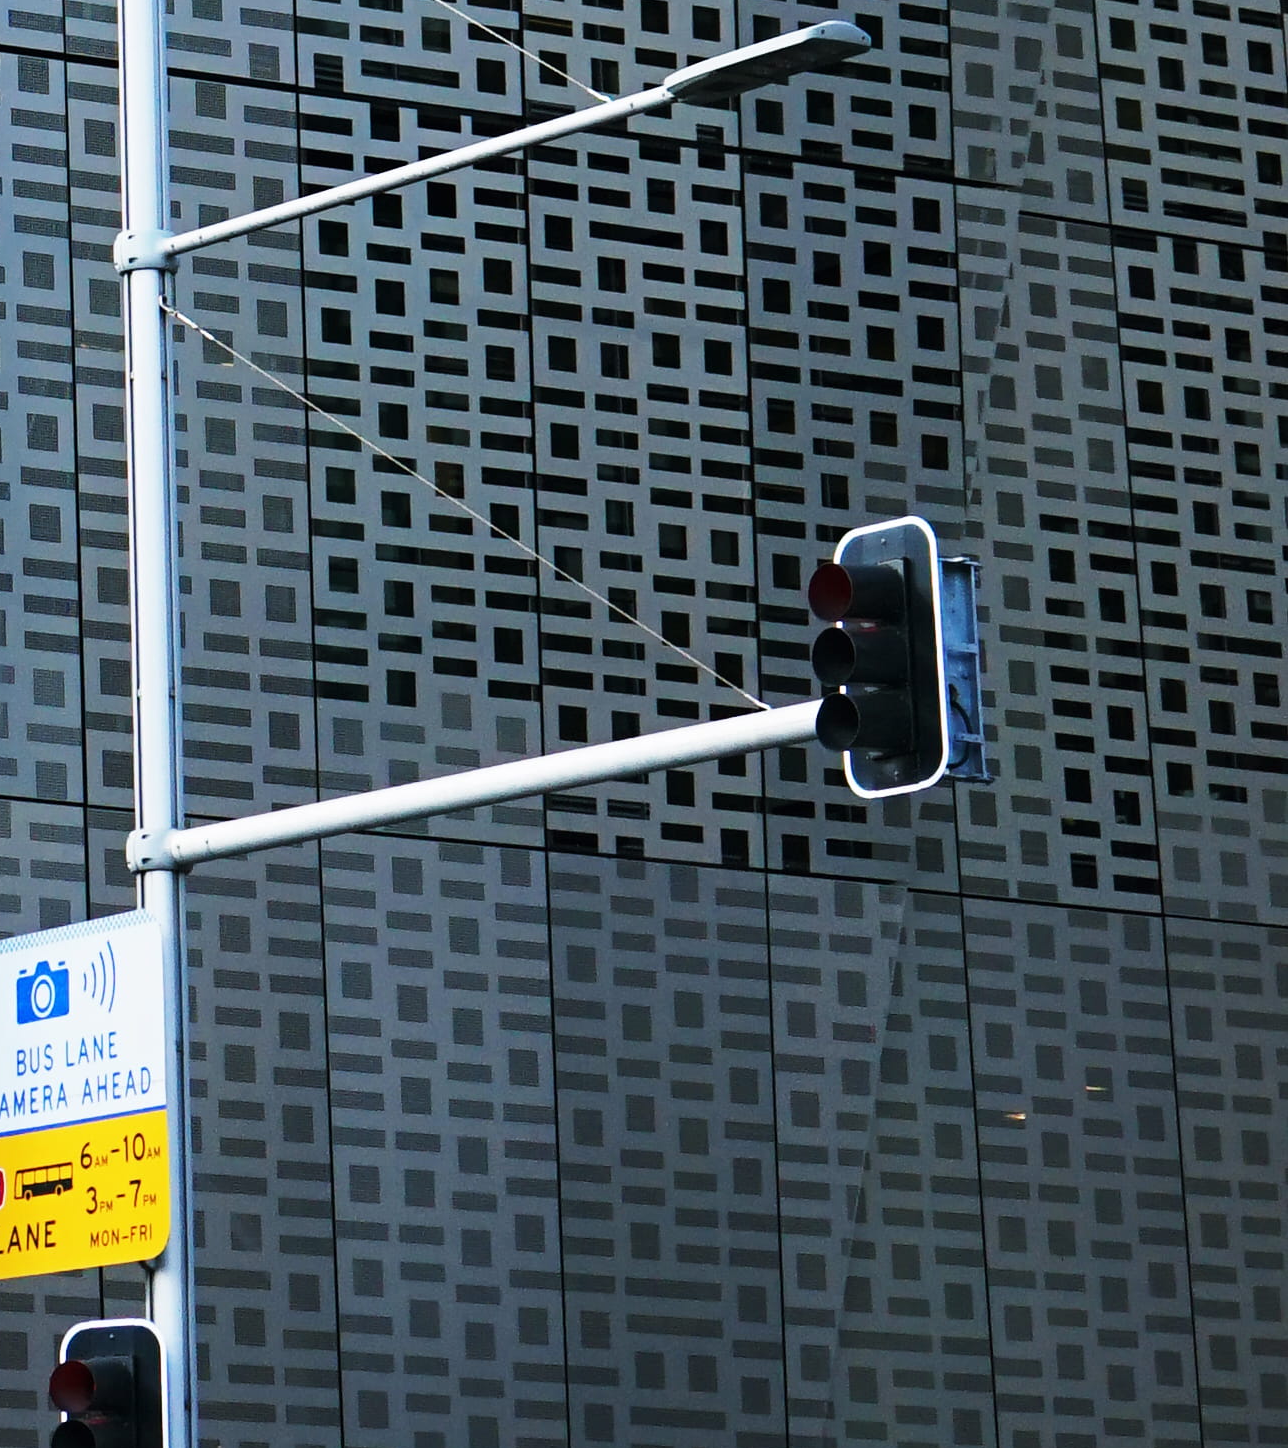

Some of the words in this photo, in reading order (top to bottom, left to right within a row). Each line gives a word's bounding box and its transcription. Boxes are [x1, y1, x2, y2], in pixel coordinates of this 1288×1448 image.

[16, 1043, 54, 1076] BUS
[66, 1031, 117, 1065] LANE
[82, 1066, 152, 1106] AHEAD
[90, 1222, 153, 1249] MON-FRI
